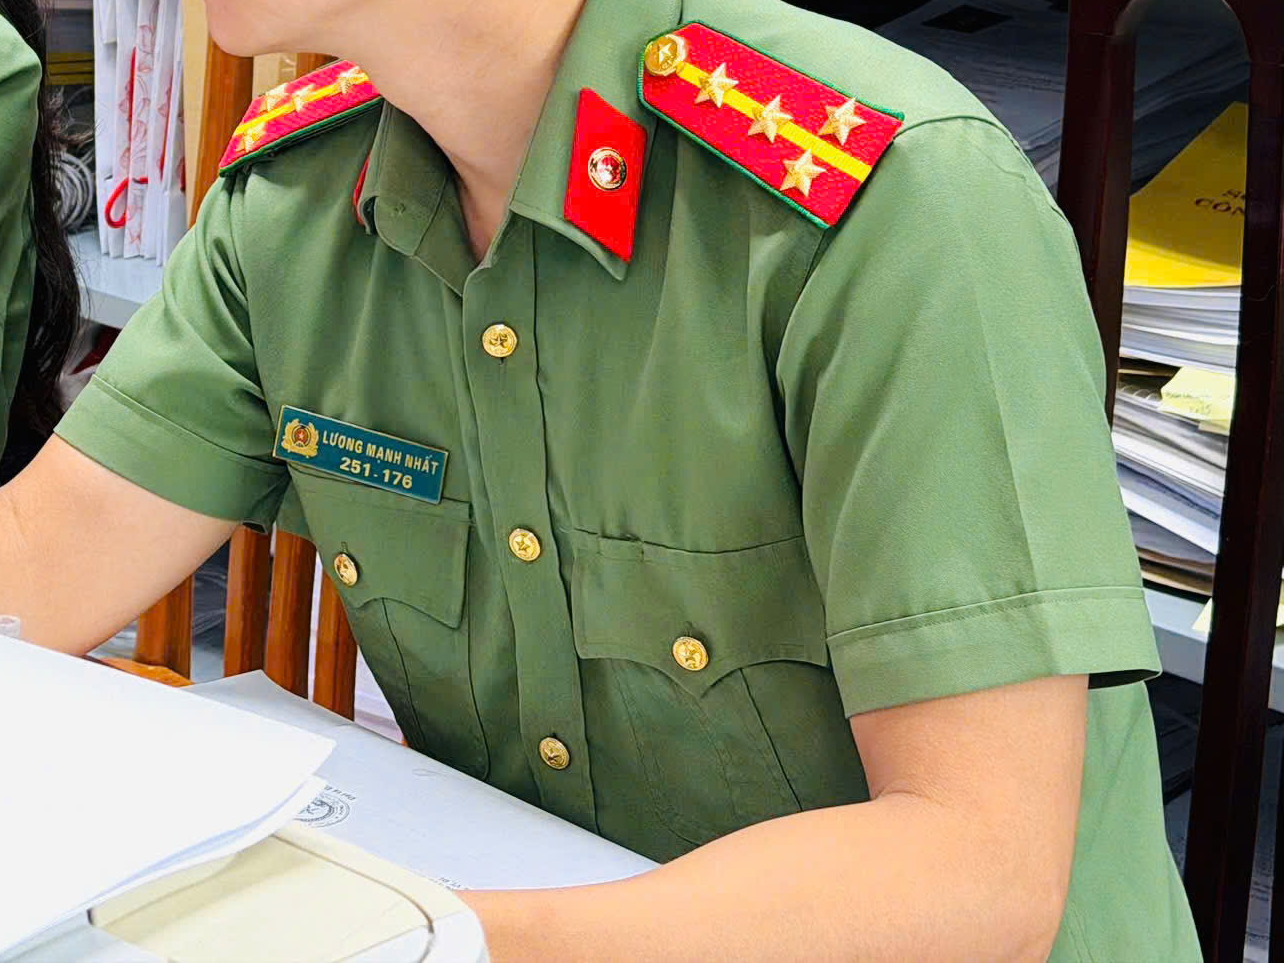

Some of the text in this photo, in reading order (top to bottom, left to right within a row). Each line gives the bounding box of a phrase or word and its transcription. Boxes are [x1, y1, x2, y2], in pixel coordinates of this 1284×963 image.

[322, 430, 440, 476] LƯƠNG MẠNH NHẤT
